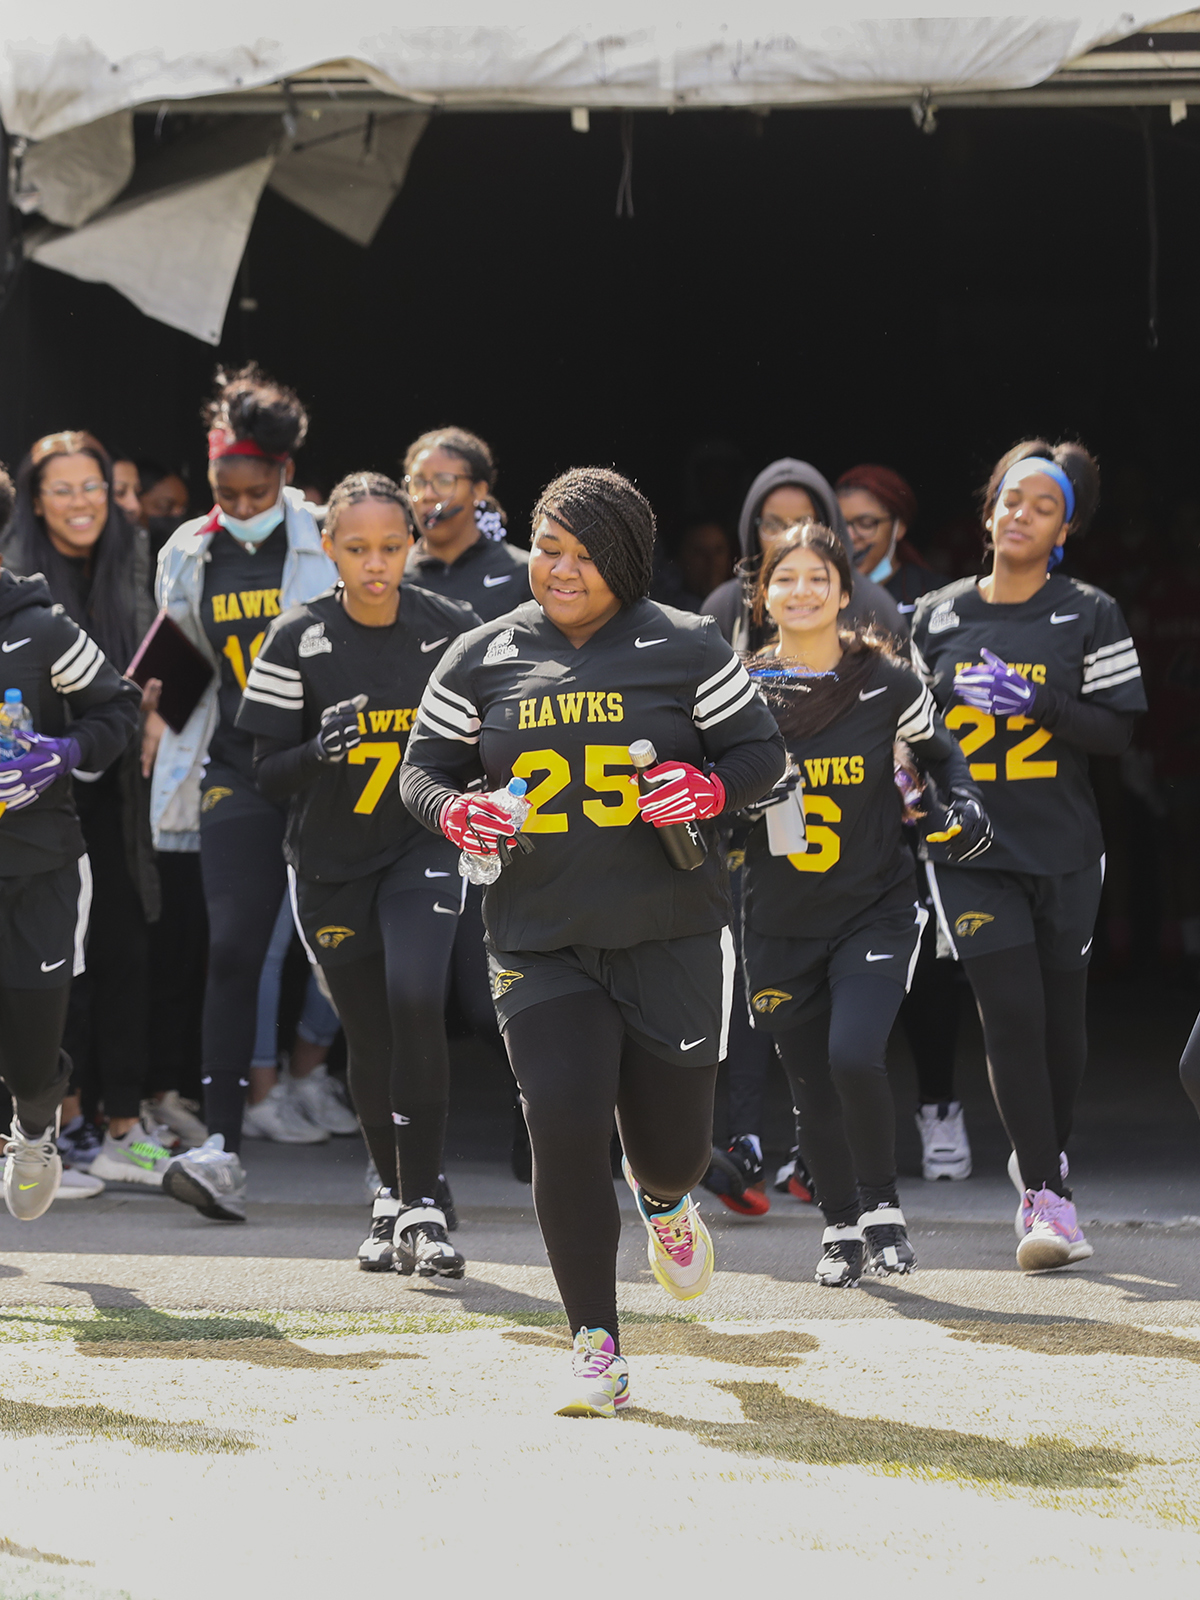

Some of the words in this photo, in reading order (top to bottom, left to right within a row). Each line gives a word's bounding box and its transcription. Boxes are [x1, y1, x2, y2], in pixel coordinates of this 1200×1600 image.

[518, 691, 624, 730] HAWKS
[944, 704, 1070, 782] 22
[347, 741, 402, 815] 7
[511, 744, 642, 834] 25
